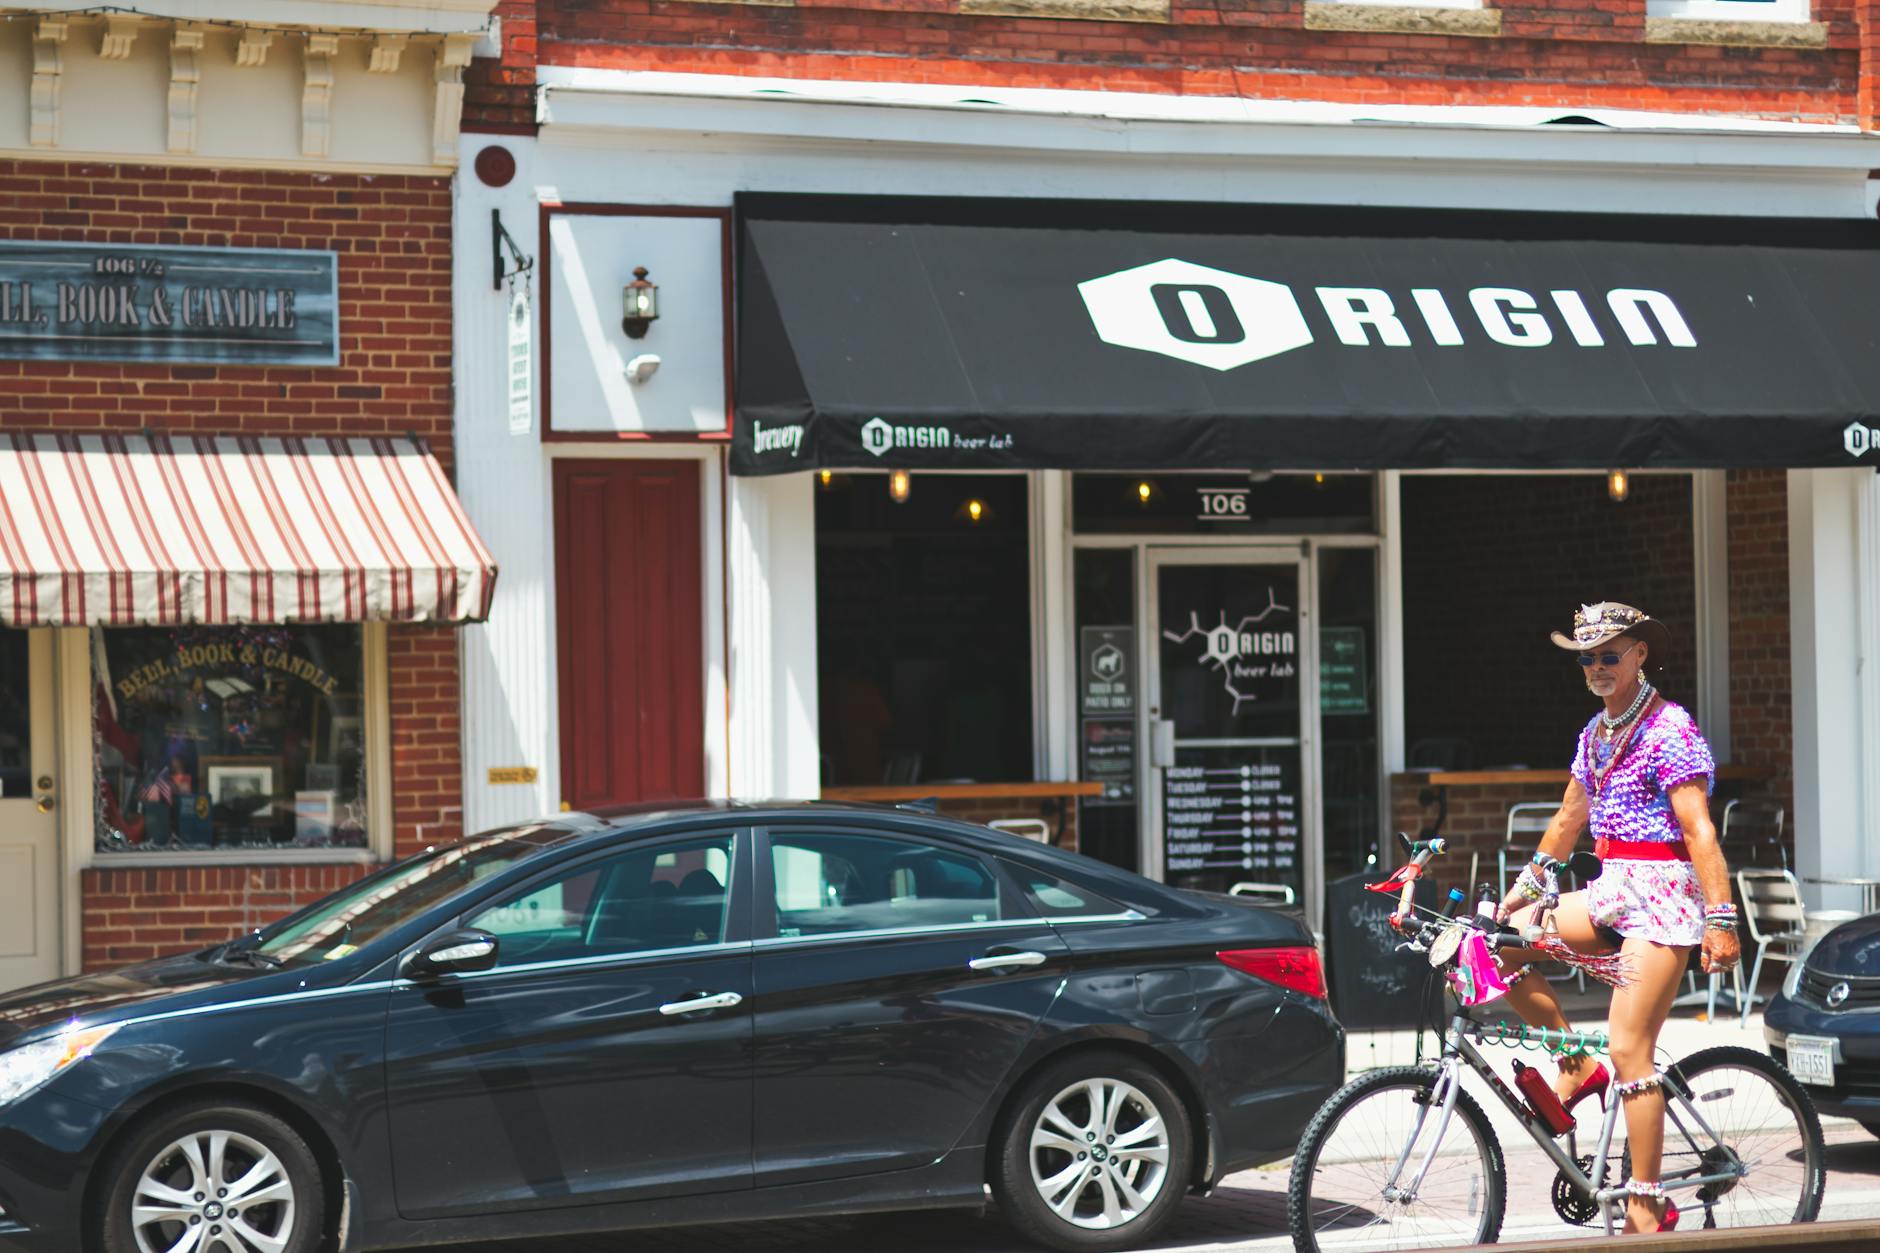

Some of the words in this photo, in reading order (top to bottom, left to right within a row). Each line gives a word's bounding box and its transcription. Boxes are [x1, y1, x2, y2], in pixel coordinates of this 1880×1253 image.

[95, 258, 135, 273] 106
[57, 282, 140, 325] BOOK
[148, 285, 174, 326] &
[182, 286, 295, 328] CANDLE
[1077, 258, 1698, 371] ORIGIN
[753, 420, 804, 457] brewery
[861, 417, 950, 457] ORIGIN
[953, 434, 986, 449] beer
[989, 433, 1013, 449] lab
[1201, 494, 1247, 514] 106
[1208, 624, 1294, 663] ORIGIN
[176, 644, 235, 669] BOOK
[240, 645, 256, 664] &
[263, 647, 338, 695] CANDLE
[1234, 662, 1266, 677] beer
[1270, 662, 1294, 677] lab
